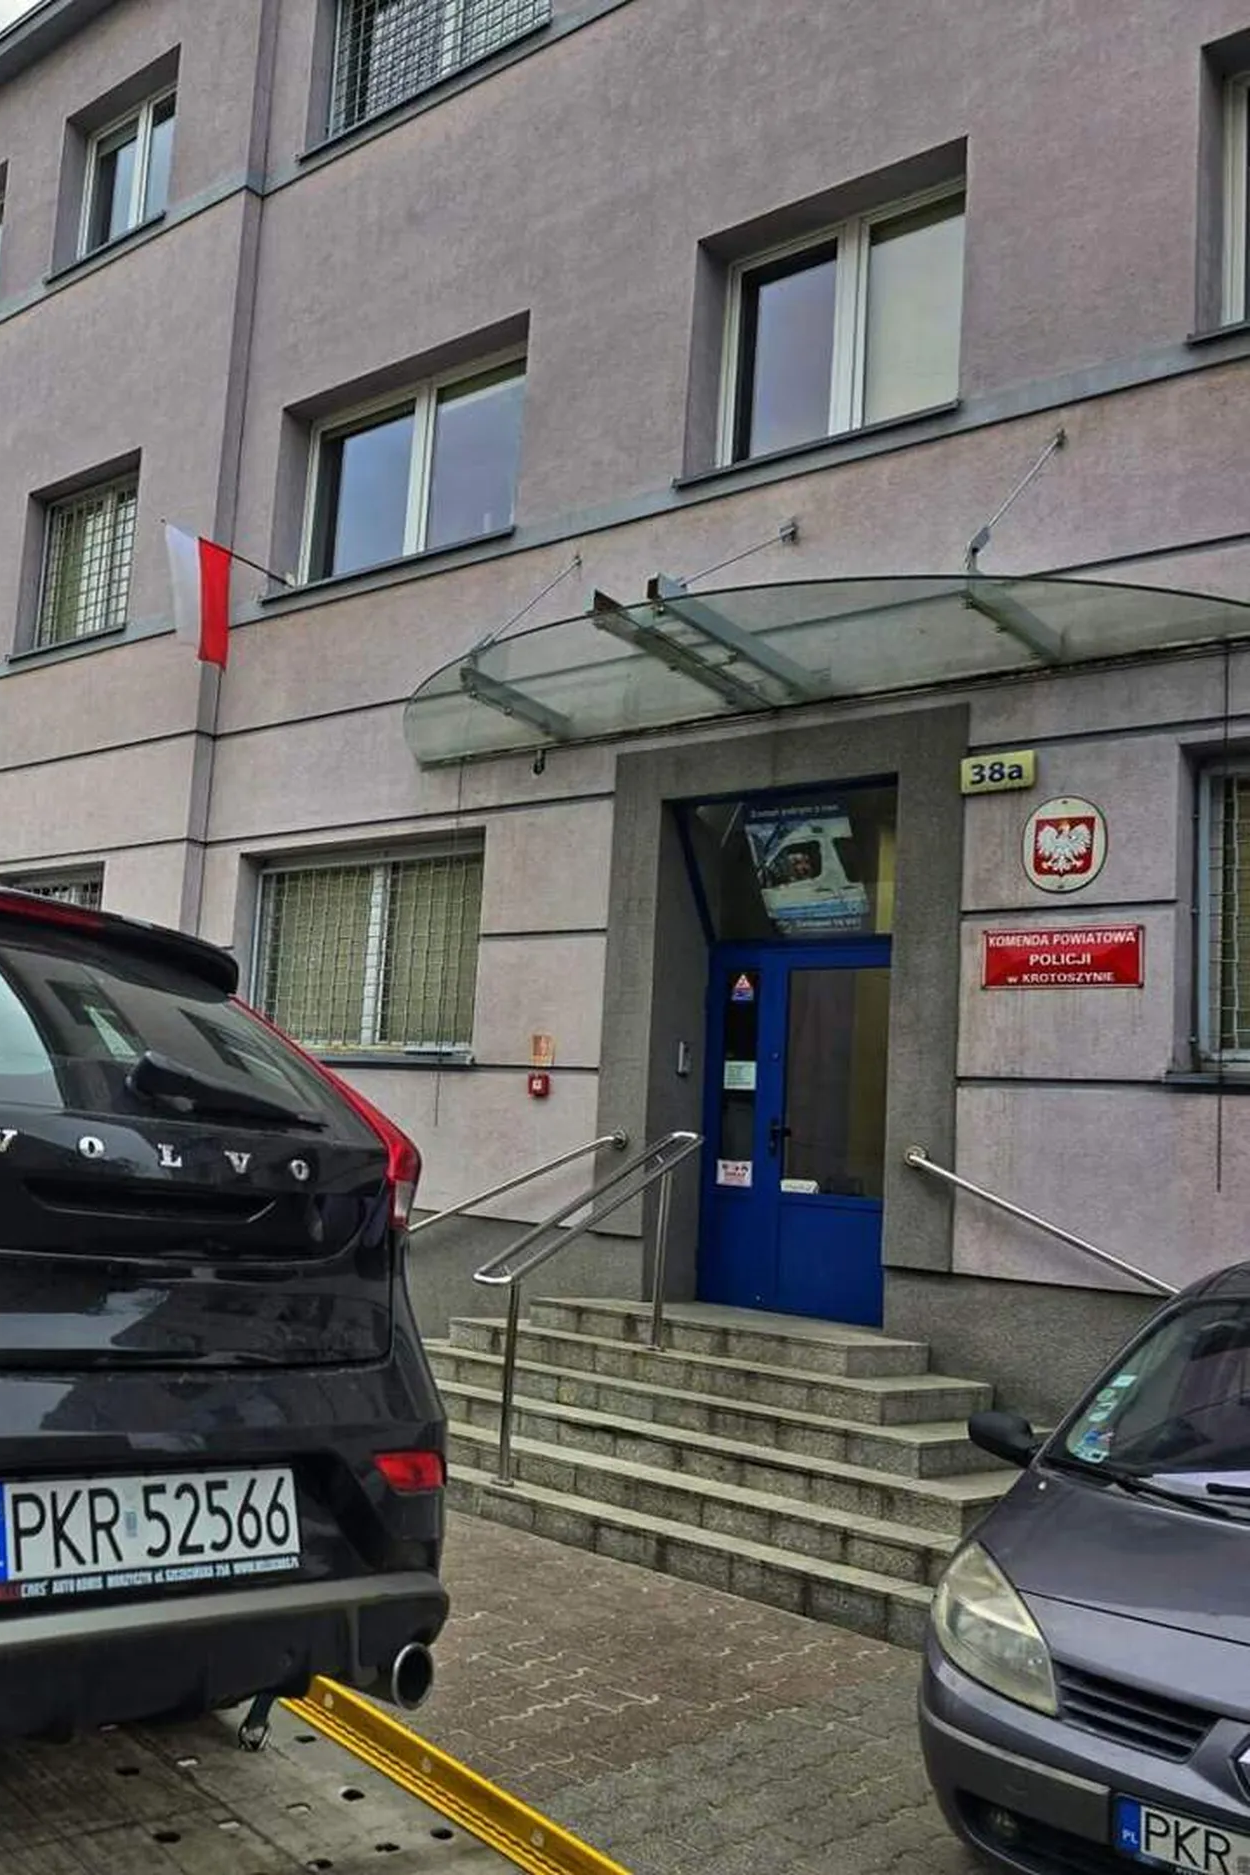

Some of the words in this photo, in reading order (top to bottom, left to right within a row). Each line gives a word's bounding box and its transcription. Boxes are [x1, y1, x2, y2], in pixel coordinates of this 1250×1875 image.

[969, 761, 1024, 786] 38a
[988, 933, 1050, 948] KOMENDA
[1053, 931, 1136, 945] POWIATOWA
[1028, 953, 1092, 967] POLICJI
[1021, 971, 1115, 984] KROTOSZYNIE
[10, 1486, 123, 1572] PKR
[142, 1476, 291, 1559] 52566
[1121, 1829, 1139, 1845] PL
[1144, 1811, 1232, 1875] PKR
